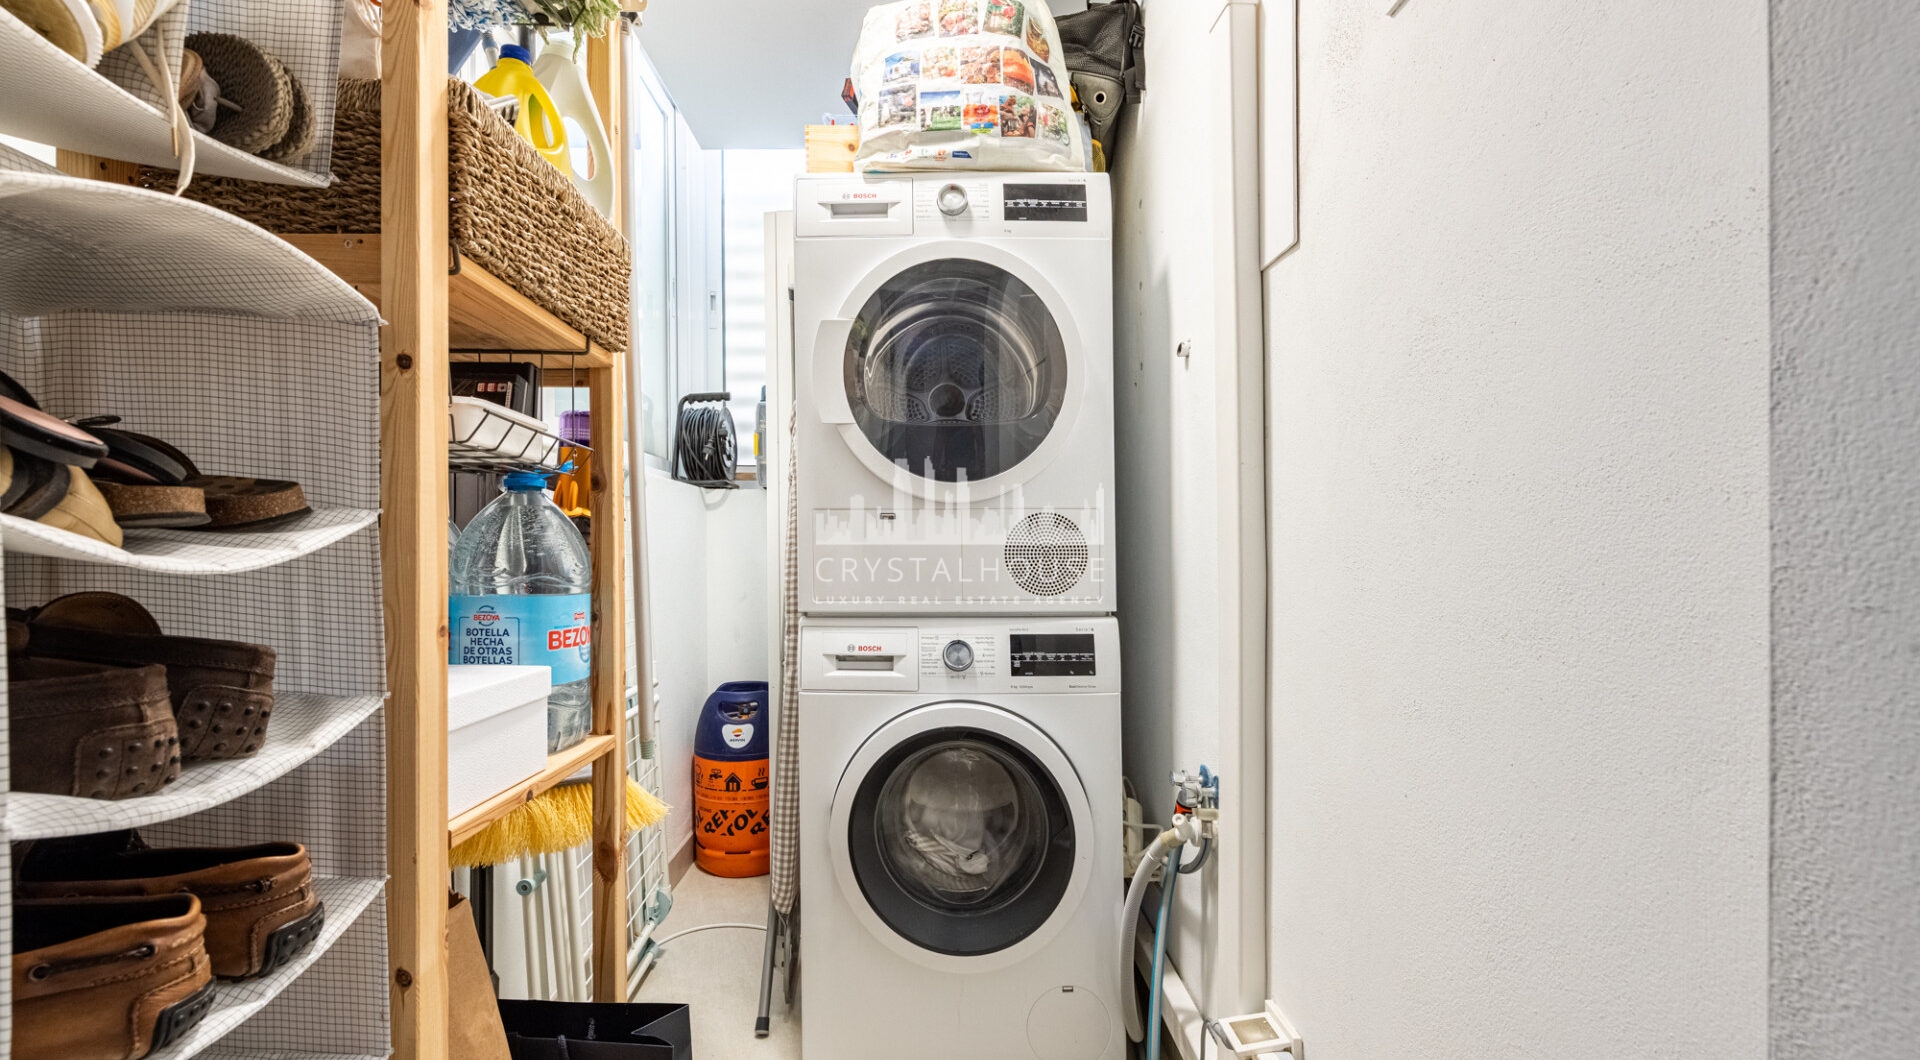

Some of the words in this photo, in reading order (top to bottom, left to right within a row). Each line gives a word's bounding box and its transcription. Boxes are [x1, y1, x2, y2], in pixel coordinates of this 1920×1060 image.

[466, 628, 510, 637] BOTELLA
[470, 637, 504, 646] HECHA
[464, 646, 475, 655] DE
[477, 646, 513, 656] OTRAS
[463, 655, 513, 665] BOTELLAS
